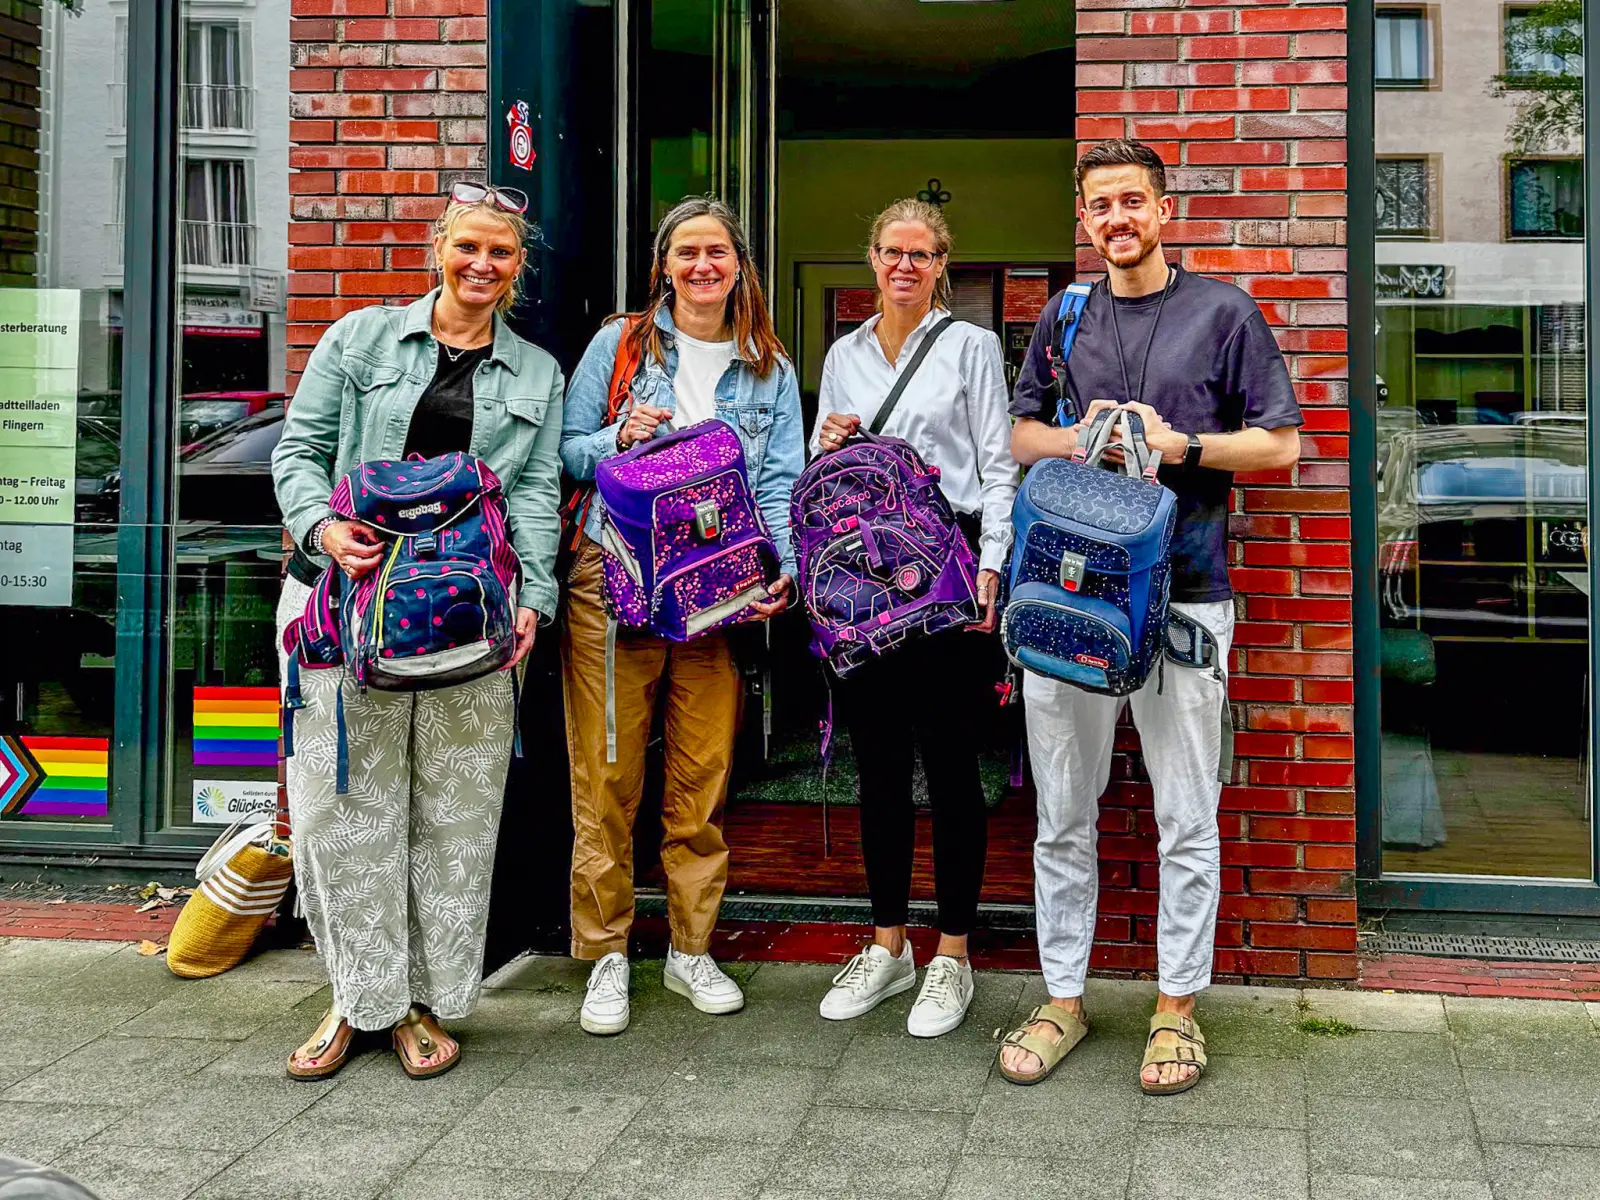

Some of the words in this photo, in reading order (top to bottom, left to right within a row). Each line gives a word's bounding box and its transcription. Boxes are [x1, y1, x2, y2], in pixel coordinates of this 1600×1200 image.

[0, 322, 68, 335] sterberatung
[2, 419, 44, 432] Flingern
[30, 476, 66, 489] Freitag
[14, 495, 39, 505] 12.00
[41, 496, 59, 506] Uhr
[398, 501, 441, 520] ergobag
